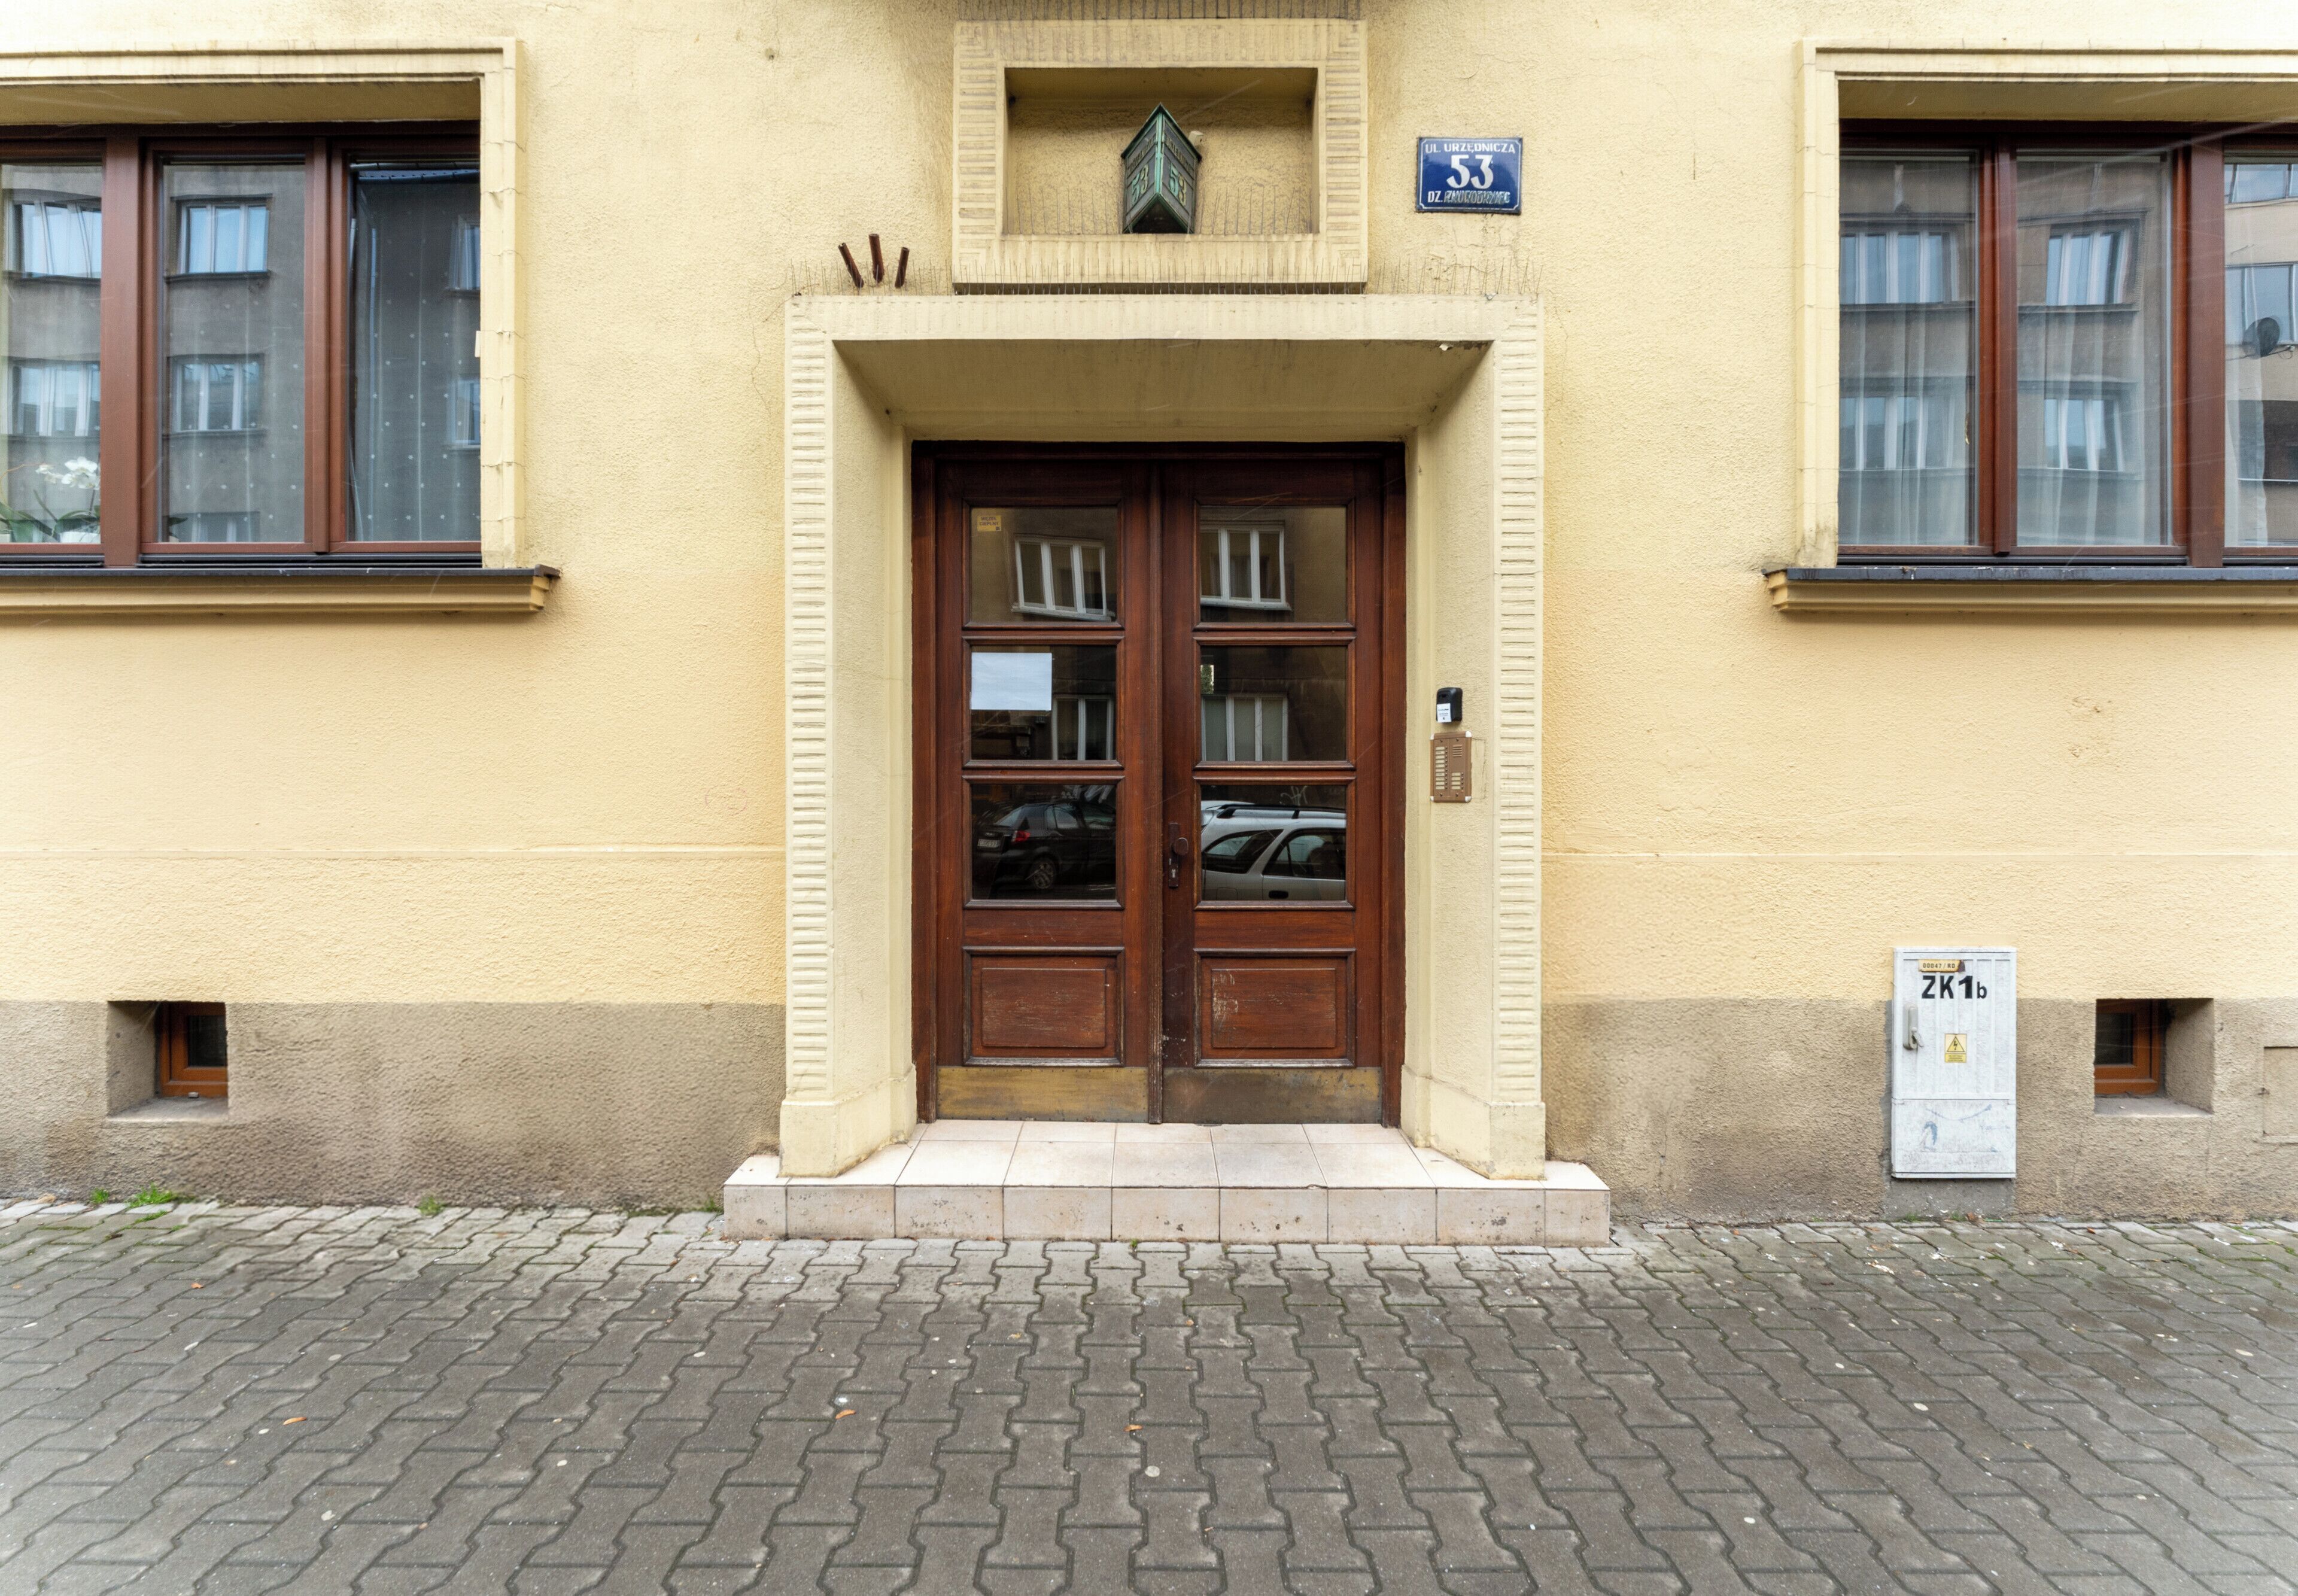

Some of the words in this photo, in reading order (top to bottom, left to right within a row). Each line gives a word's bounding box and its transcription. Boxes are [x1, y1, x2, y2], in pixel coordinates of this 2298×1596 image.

[1425, 144, 1441, 153] UL.
[1444, 143, 1516, 153] URZĘDNICZA
[1446, 154, 1494, 189] 53
[1428, 191, 1443, 203] DZ.
